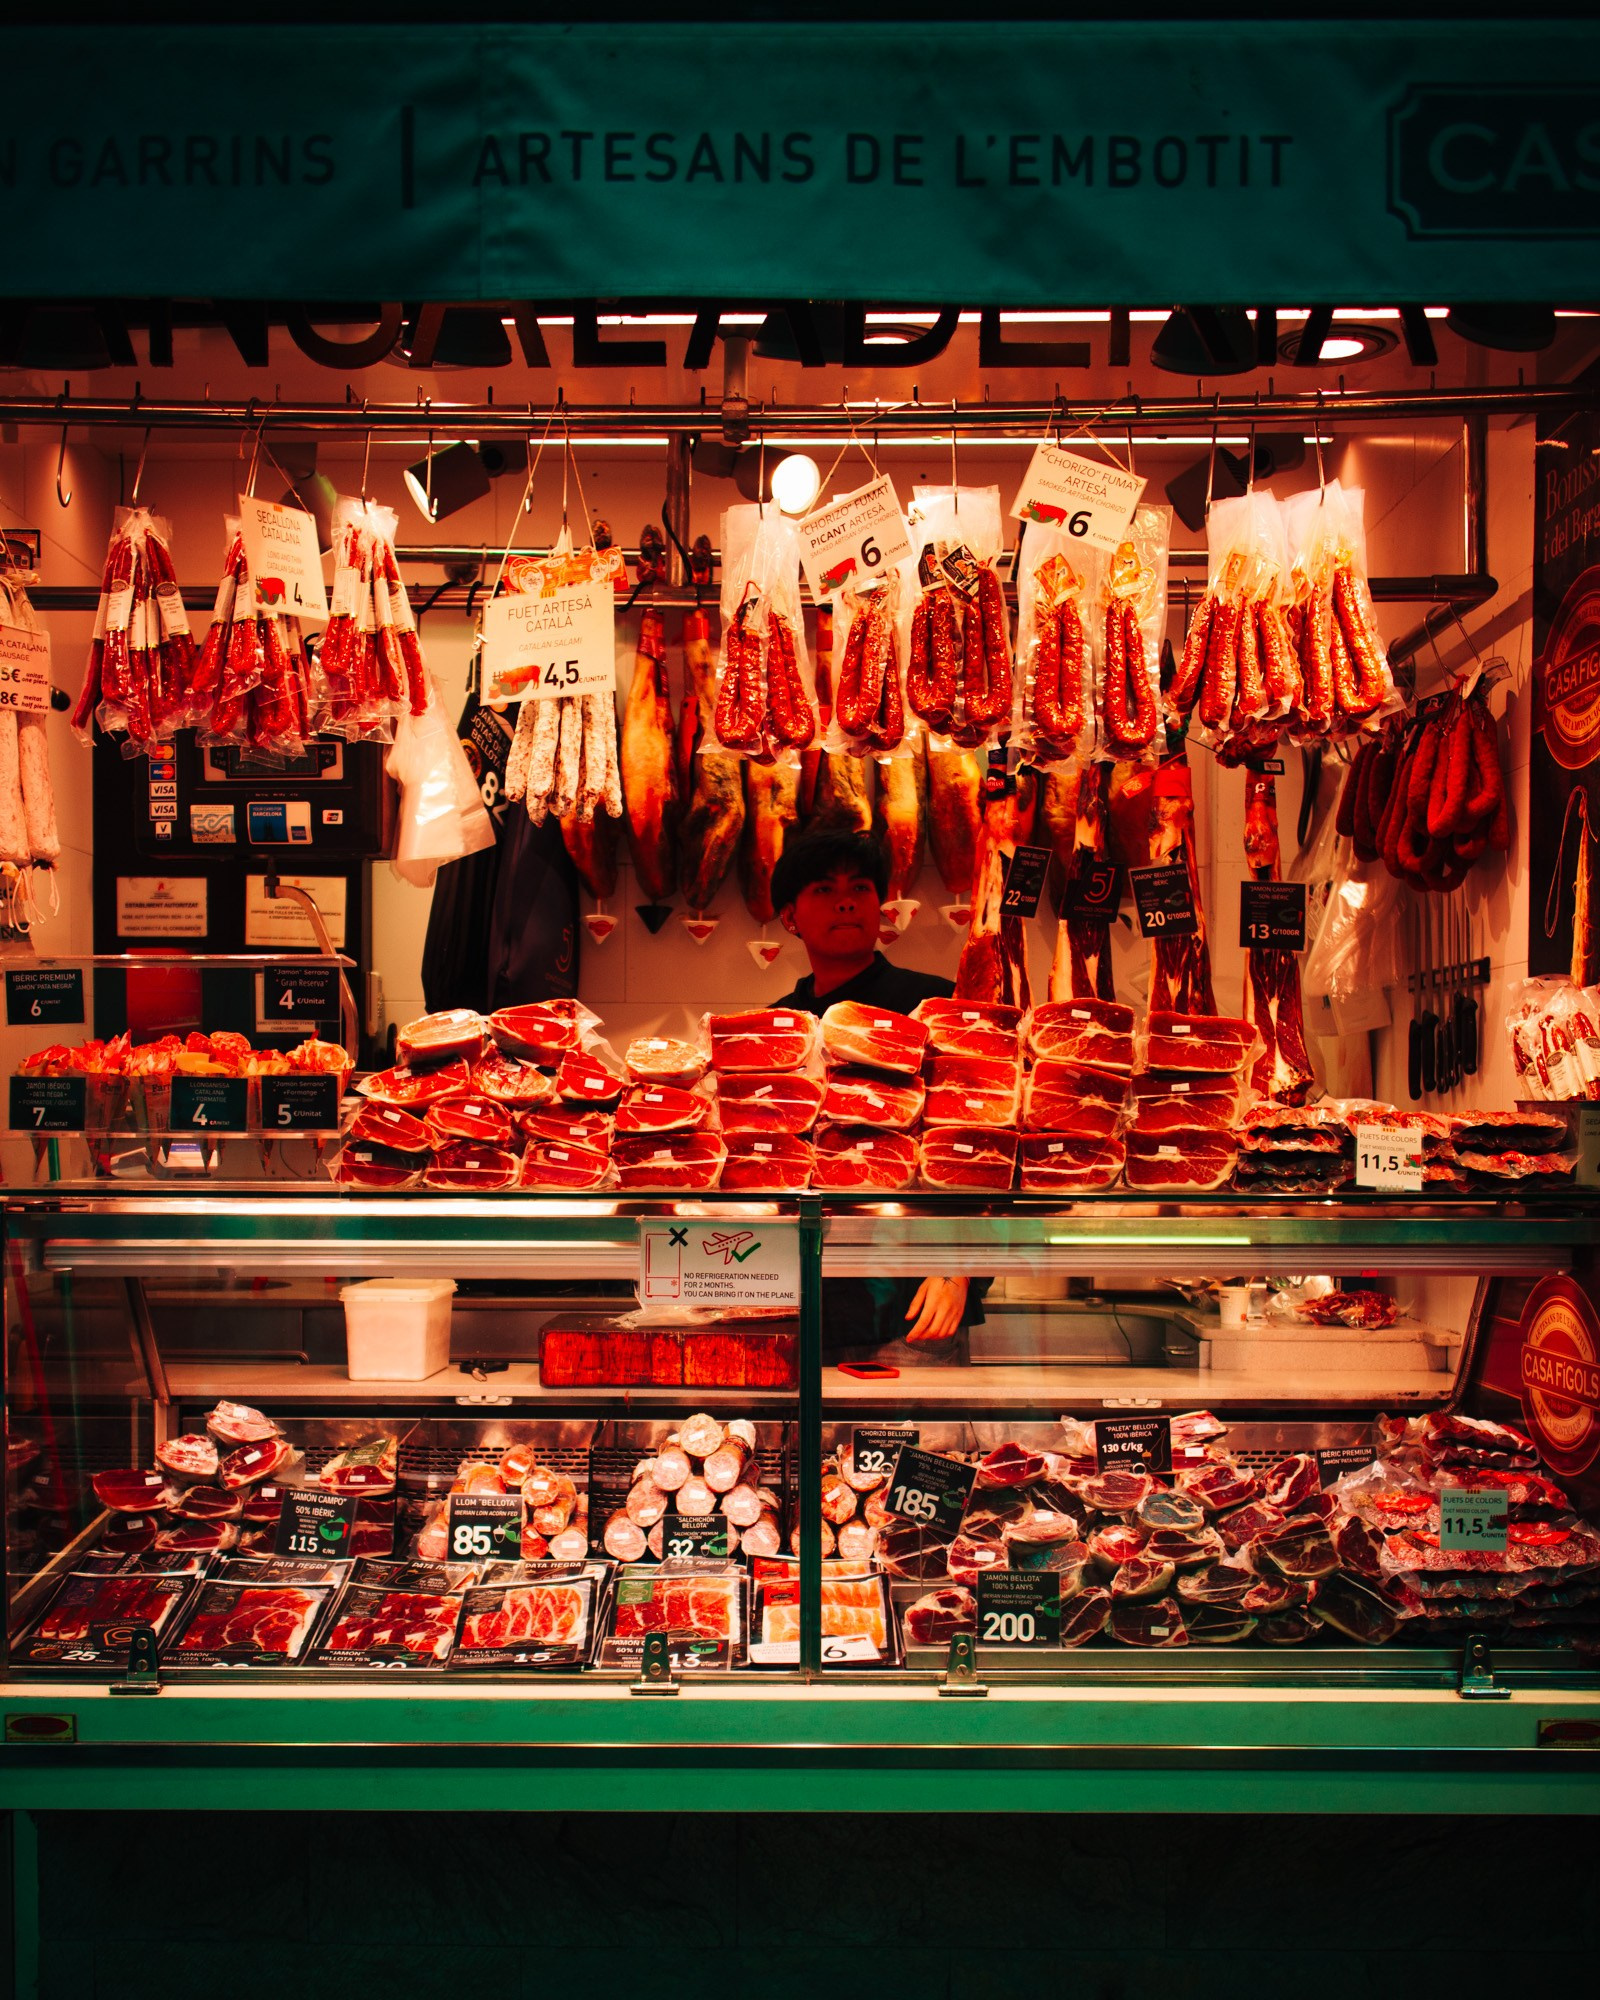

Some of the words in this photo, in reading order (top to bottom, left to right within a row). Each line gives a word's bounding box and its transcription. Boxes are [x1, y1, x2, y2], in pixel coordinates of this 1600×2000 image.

[48, 135, 336, 187] GARRINS
[472, 131, 813, 186] ARTESANS
[847, 133, 923, 186] DE
[955, 134, 1293, 188] L'EMBOTIT
[1064, 475, 1107, 497] ARTESÀ
[1102, 471, 1139, 493] FUMAT
[854, 483, 889, 509] FUMAT
[1095, 499, 1127, 514] CHORIZO
[810, 523, 847, 548] PICANT
[849, 503, 886, 529] ARTESÀ
[1068, 510, 1093, 538] 6
[261, 525, 301, 546] CATALANA
[861, 536, 881, 567] 6
[294, 582, 303, 606] 4
[507, 605, 539, 621] FUET
[542, 595, 593, 615] ARTESÀ
[526, 613, 573, 633] CATALÀ
[6, 640, 48, 653] CATALANA
[544, 659, 579, 690] 4,5
[1548, 664, 1578, 700] CASA
[154, 786, 175, 794] VISA
[154, 805, 175, 814] VISA
[1153, 870, 1176, 879] BELLOTA
[1005, 890, 1021, 906] 22
[1145, 910, 1166, 928] 20
[1167, 911, 1191, 921] €/100GR
[1248, 923, 1270, 939] 13
[1272, 928, 1300, 937] €/100GR
[40, 973, 76, 981] PREMIUM
[31, 1000, 41, 1017] 6
[279, 989, 294, 1010] 4
[32, 1107, 46, 1127] 7
[192, 1103, 208, 1126] 4
[278, 1103, 292, 1125] 5
[1391, 1135, 1418, 1143] COLORS
[1361, 1153, 1399, 1172] 11,5
[695, 1273, 749, 1281] REFRIGERATION
[750, 1273, 779, 1281] NEEDED
[699, 1291, 713, 1299] CAN
[714, 1291, 736, 1299] BRING
[737, 1291, 743, 1299] IT
[744, 1291, 755, 1299] ON
[756, 1291, 771, 1299] THE
[771, 1291, 796, 1299] PLANE.
[1524, 1352, 1554, 1386] CASA
[1102, 1443, 1120, 1453] 130
[1121, 1441, 1144, 1453] €/kg
[1342, 1448, 1372, 1456] PREMIUM
[859, 1450, 885, 1472] 32
[290, 1492, 318, 1502] "JAMÓN
[318, 1495, 348, 1506] CAMPO"
[455, 1498, 477, 1506] LLOM
[478, 1498, 517, 1507] "BELLOTA"
[894, 1485, 940, 1521] 185
[1443, 1496, 1464, 1504] FUETS
[295, 1505, 310, 1515] 50%
[1444, 1517, 1484, 1537] 11,5
[288, 1534, 319, 1553] 115
[453, 1525, 491, 1556] 85
[668, 1538, 694, 1558] 32
[272, 1560, 296, 1568] PATA
[297, 1562, 328, 1570] NEGRA
[435, 1563, 466, 1572] NEGRA
[983, 1611, 1035, 1642] 200
[61, 1650, 101, 1661] 25
[514, 1652, 551, 1663] 15
[669, 1653, 701, 1668] 13
[823, 1645, 847, 1659] 6
